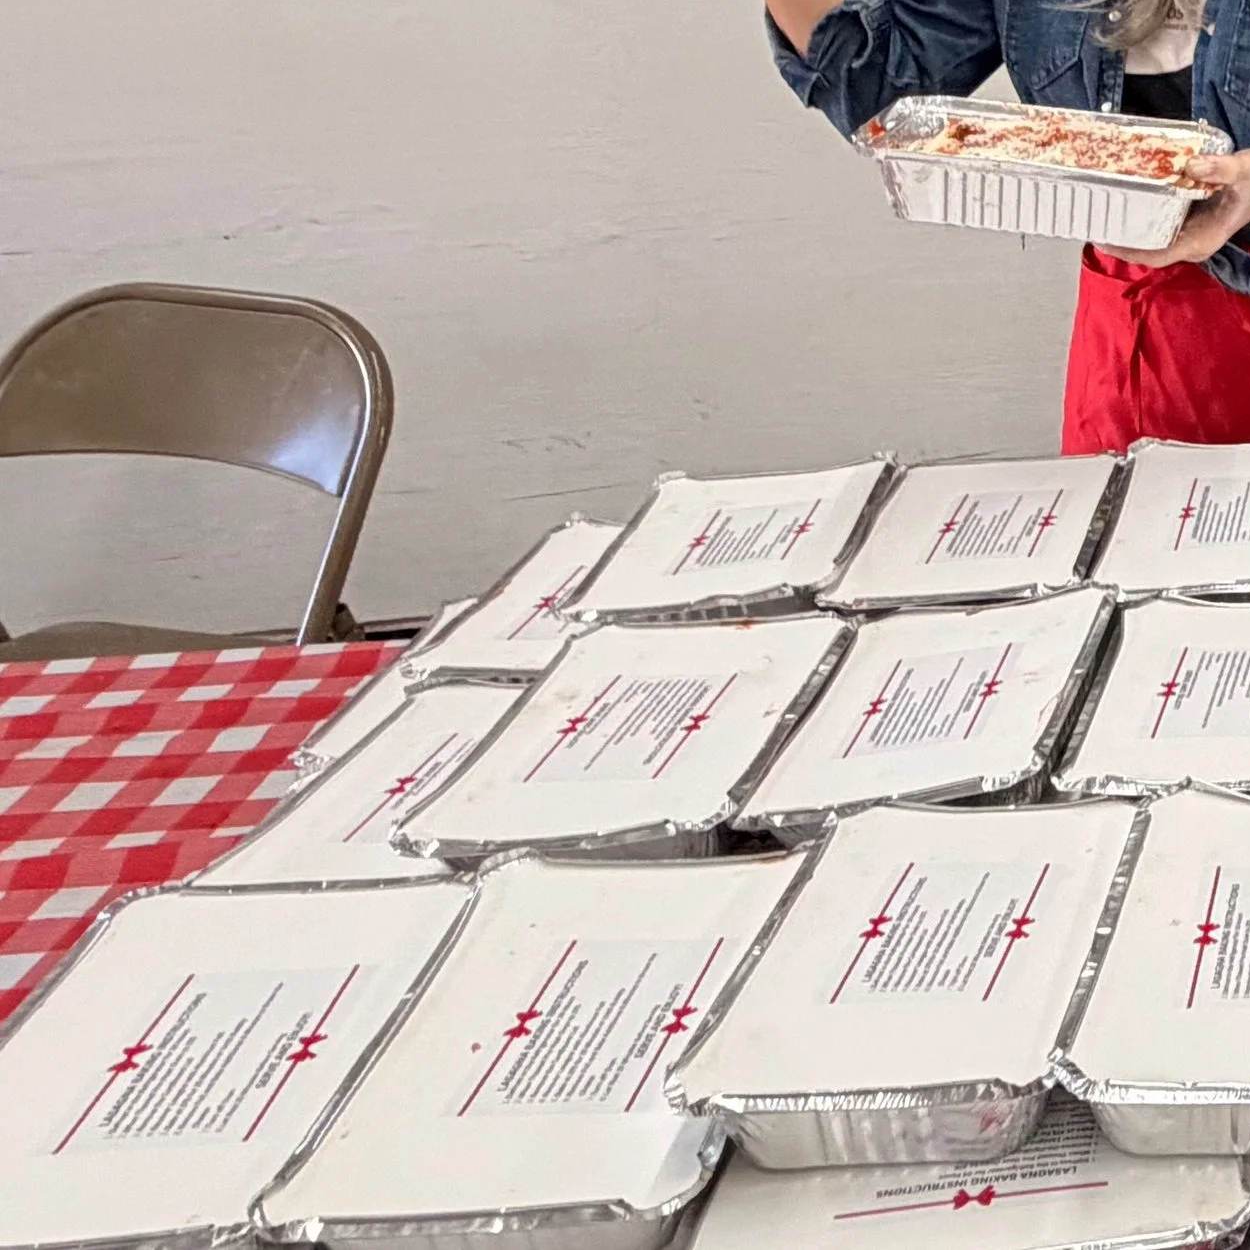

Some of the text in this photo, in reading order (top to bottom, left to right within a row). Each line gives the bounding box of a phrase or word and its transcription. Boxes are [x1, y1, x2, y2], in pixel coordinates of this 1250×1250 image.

[876, 1166, 1077, 1199] LASAGNA BAKING INSTRUCTIONS
